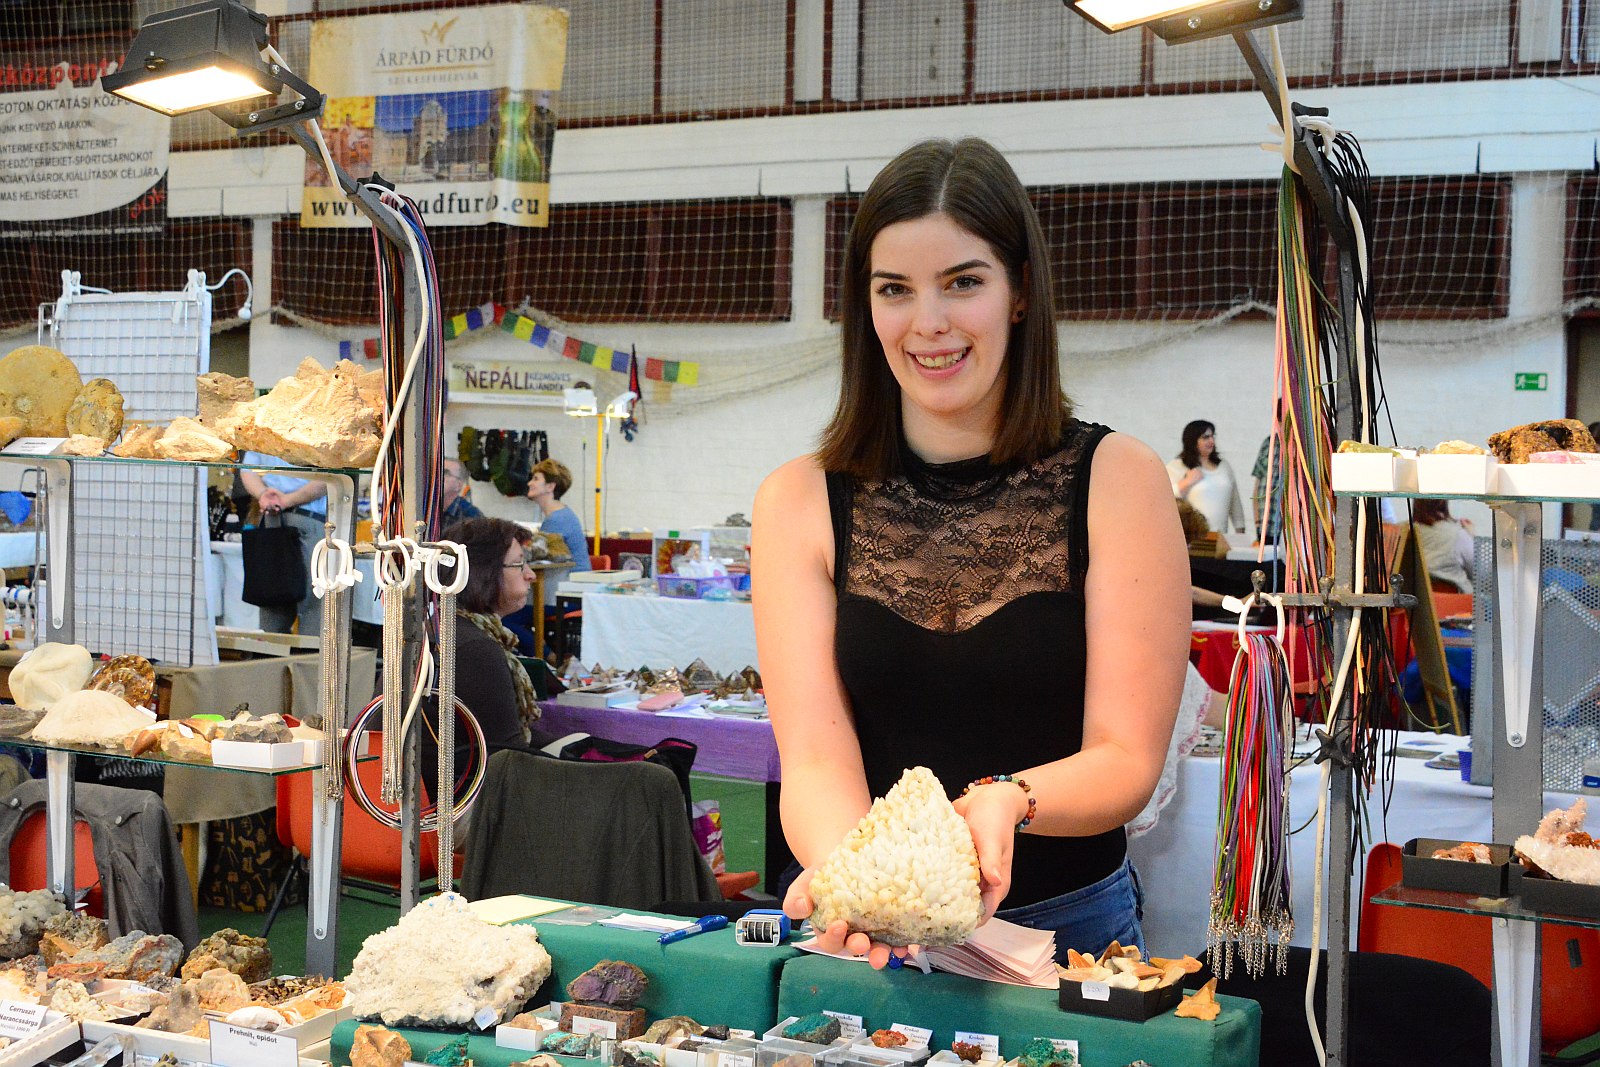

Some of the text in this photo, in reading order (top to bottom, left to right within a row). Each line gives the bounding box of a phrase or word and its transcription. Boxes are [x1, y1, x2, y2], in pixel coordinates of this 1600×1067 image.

[376, 46, 432, 67] ÁRPÁD
[37, 95, 91, 112] OKTATÁSI
[465, 365, 529, 391] NEPÁLI
[9, 1005, 36, 1016] Cerruszit
[229, 1027, 278, 1045] Prehnit, epidot
